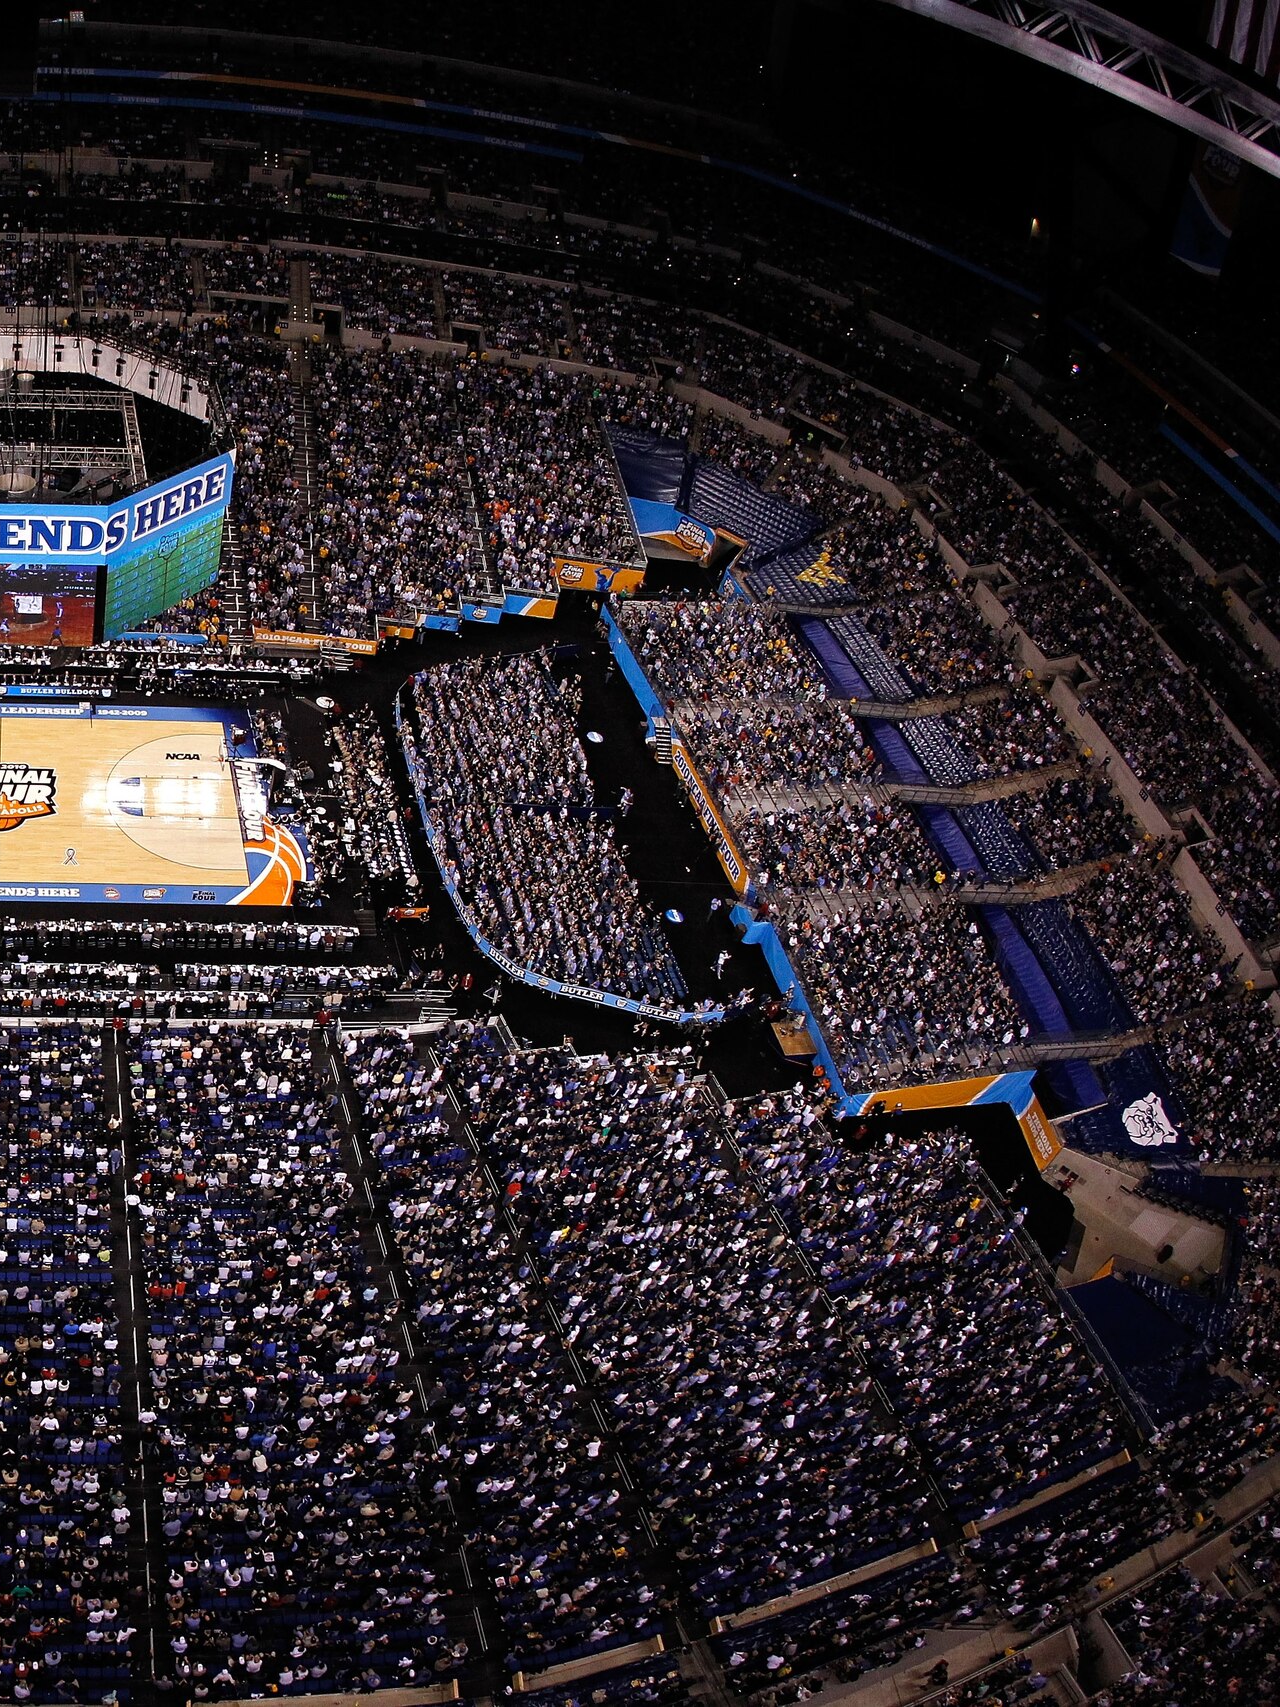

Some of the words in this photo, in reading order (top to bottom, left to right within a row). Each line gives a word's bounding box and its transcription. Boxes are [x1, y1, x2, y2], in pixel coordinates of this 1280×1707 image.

[132, 464, 226, 541] HERE
[676, 523, 705, 545] FOUR
[686, 522, 706, 538] FINAL
[560, 569, 584, 580] FOUR
[255, 633, 281, 641] 2010
[345, 643, 373, 652] FOUR
[1, 706, 84, 716] LEADERSHIP
[98, 709, 148, 717] 1942-2009
[165, 753, 200, 761] NCAA
[673, 748, 691, 782] 2010
[686, 773, 706, 812] NCAA
[718, 838, 741, 883] FOUR
[37, 888, 80, 897] HERE
[192, 894, 216, 902] FOUR
[488, 946, 526, 978] BUTLER
[559, 984, 605, 1001] BUTLER
[636, 1004, 682, 1021] BUTLER
[1025, 1112, 1039, 1139] ENDS
[1034, 1135, 1049, 1161] HERE
[1031, 1110, 1043, 1132] THE
[1039, 1128, 1053, 1155] ROAD
